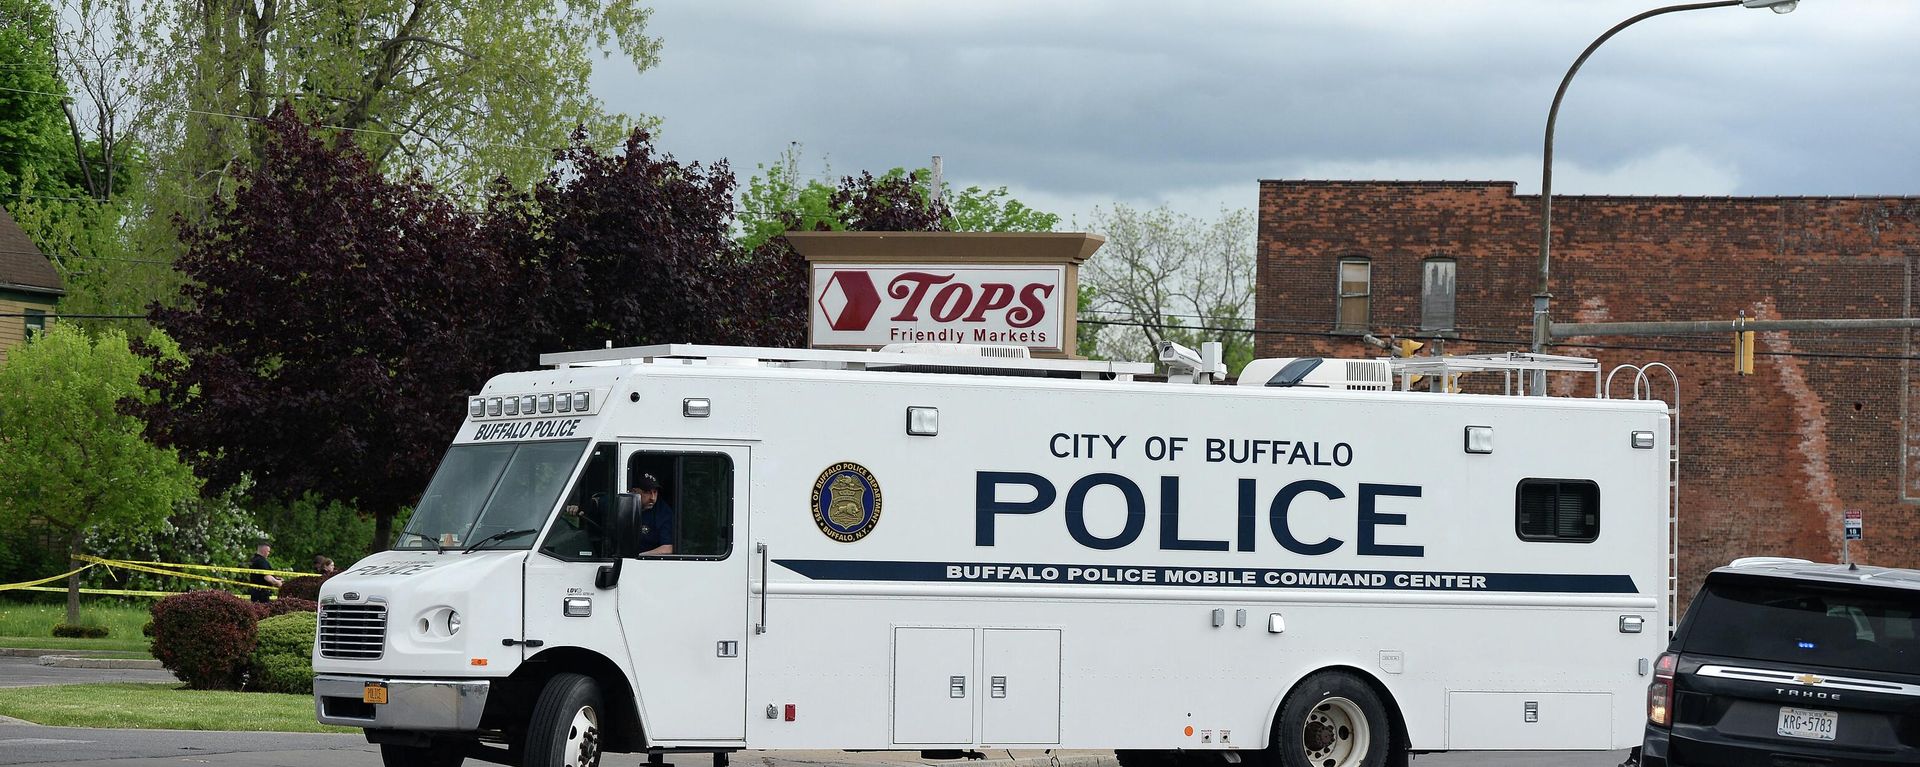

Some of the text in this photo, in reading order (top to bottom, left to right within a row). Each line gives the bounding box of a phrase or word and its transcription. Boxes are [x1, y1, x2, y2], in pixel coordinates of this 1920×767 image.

[890, 328, 1046, 343] Friendly Markets
[473, 419, 582, 440] BUFFALO POLICE
[1050, 433, 1353, 467] CITY OF BUFFALO
[812, 490, 820, 501] OF
[816, 464, 842, 489] BUFFALO
[843, 463, 868, 476] POLICE
[867, 475, 881, 524] DEPARTMENT
[975, 470, 1425, 558] POLICE
[946, 565, 1487, 589] BUFFALO POLICE MOBILE COMMAND CENTER
[1776, 688, 1840, 700] TAHOE
